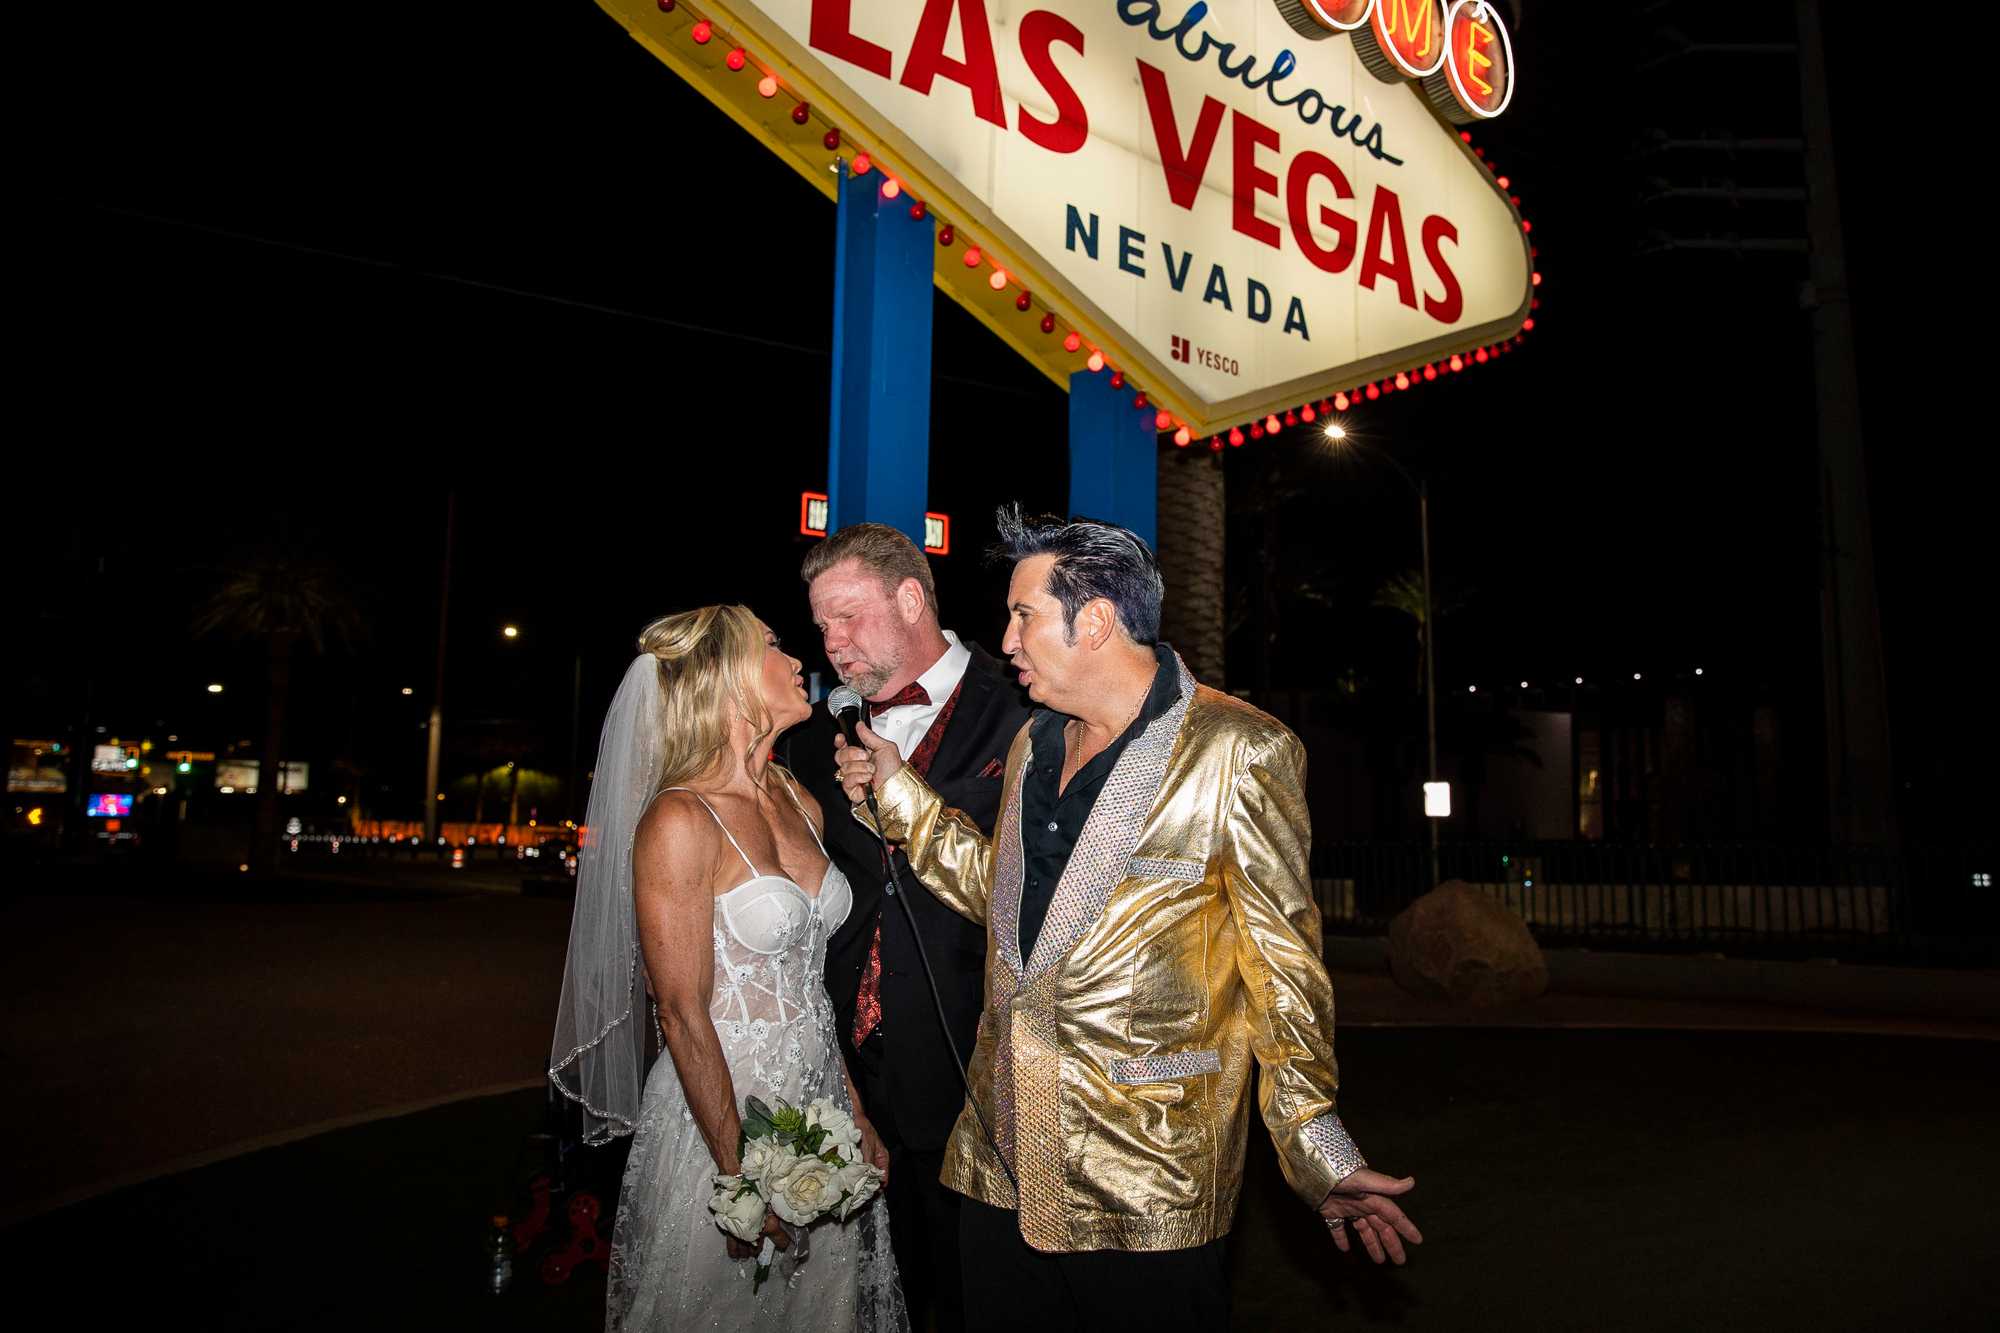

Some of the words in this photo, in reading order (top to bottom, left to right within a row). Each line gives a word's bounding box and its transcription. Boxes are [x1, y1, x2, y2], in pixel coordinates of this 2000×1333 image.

[809, 0, 1088, 154] LAS
[1136, 57, 1464, 325] VEGAS
[1066, 204, 1310, 341] NEVADA
[1197, 347, 1239, 376] YESCO
